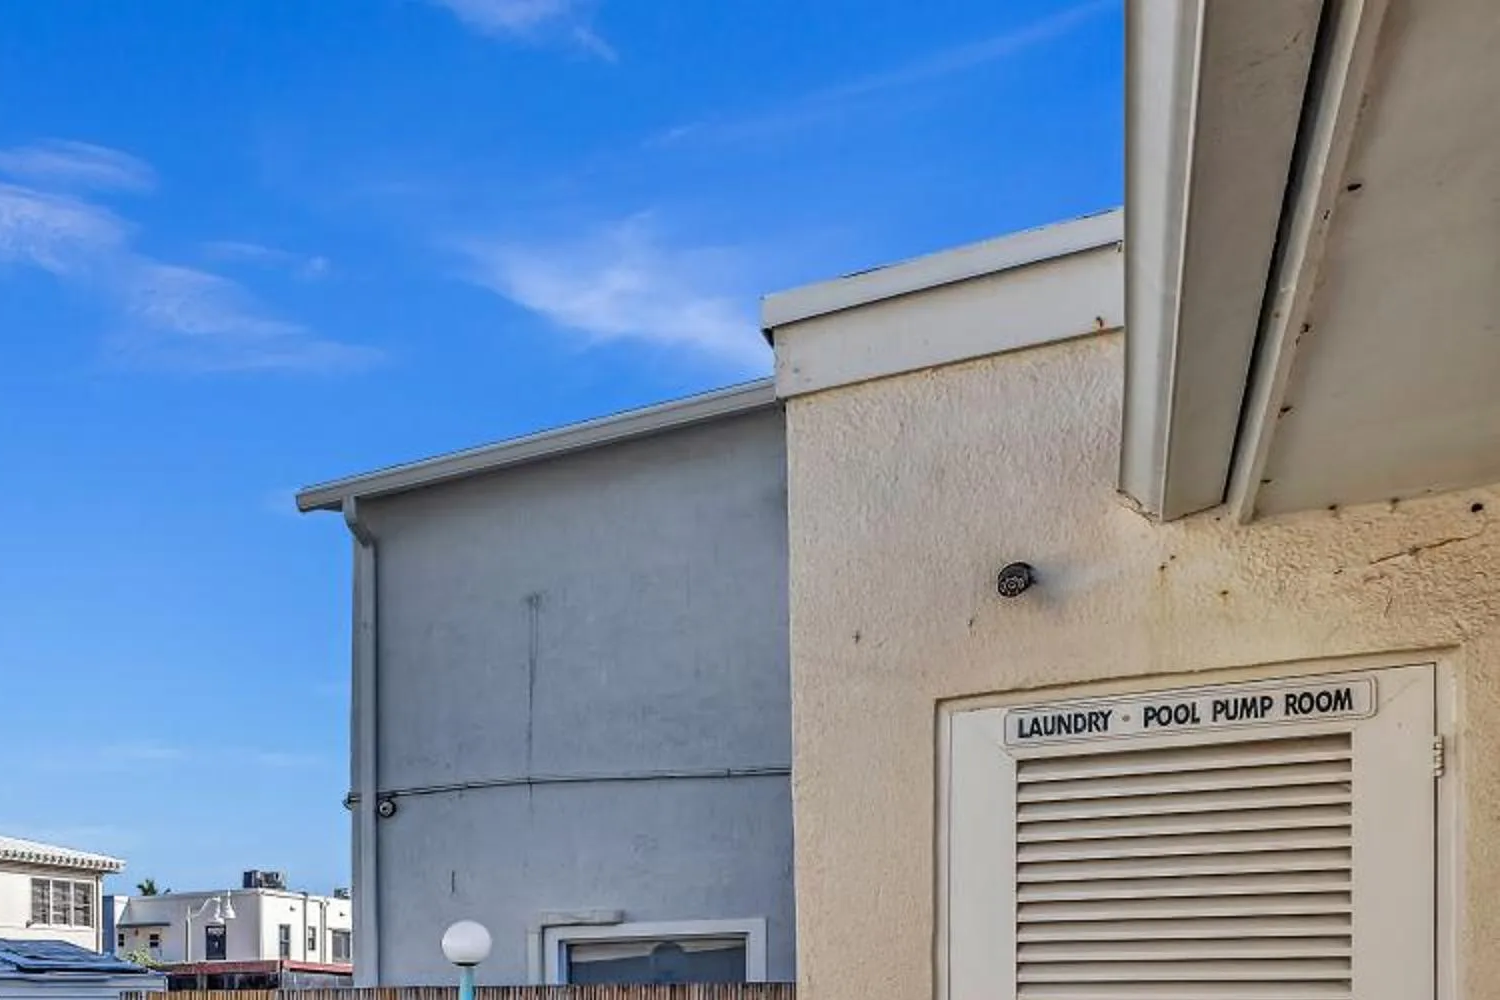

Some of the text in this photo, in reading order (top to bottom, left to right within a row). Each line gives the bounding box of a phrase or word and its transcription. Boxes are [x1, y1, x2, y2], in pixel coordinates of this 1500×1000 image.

[1017, 688, 1353, 738] LAUNDRY POOL PUMP ROOM
